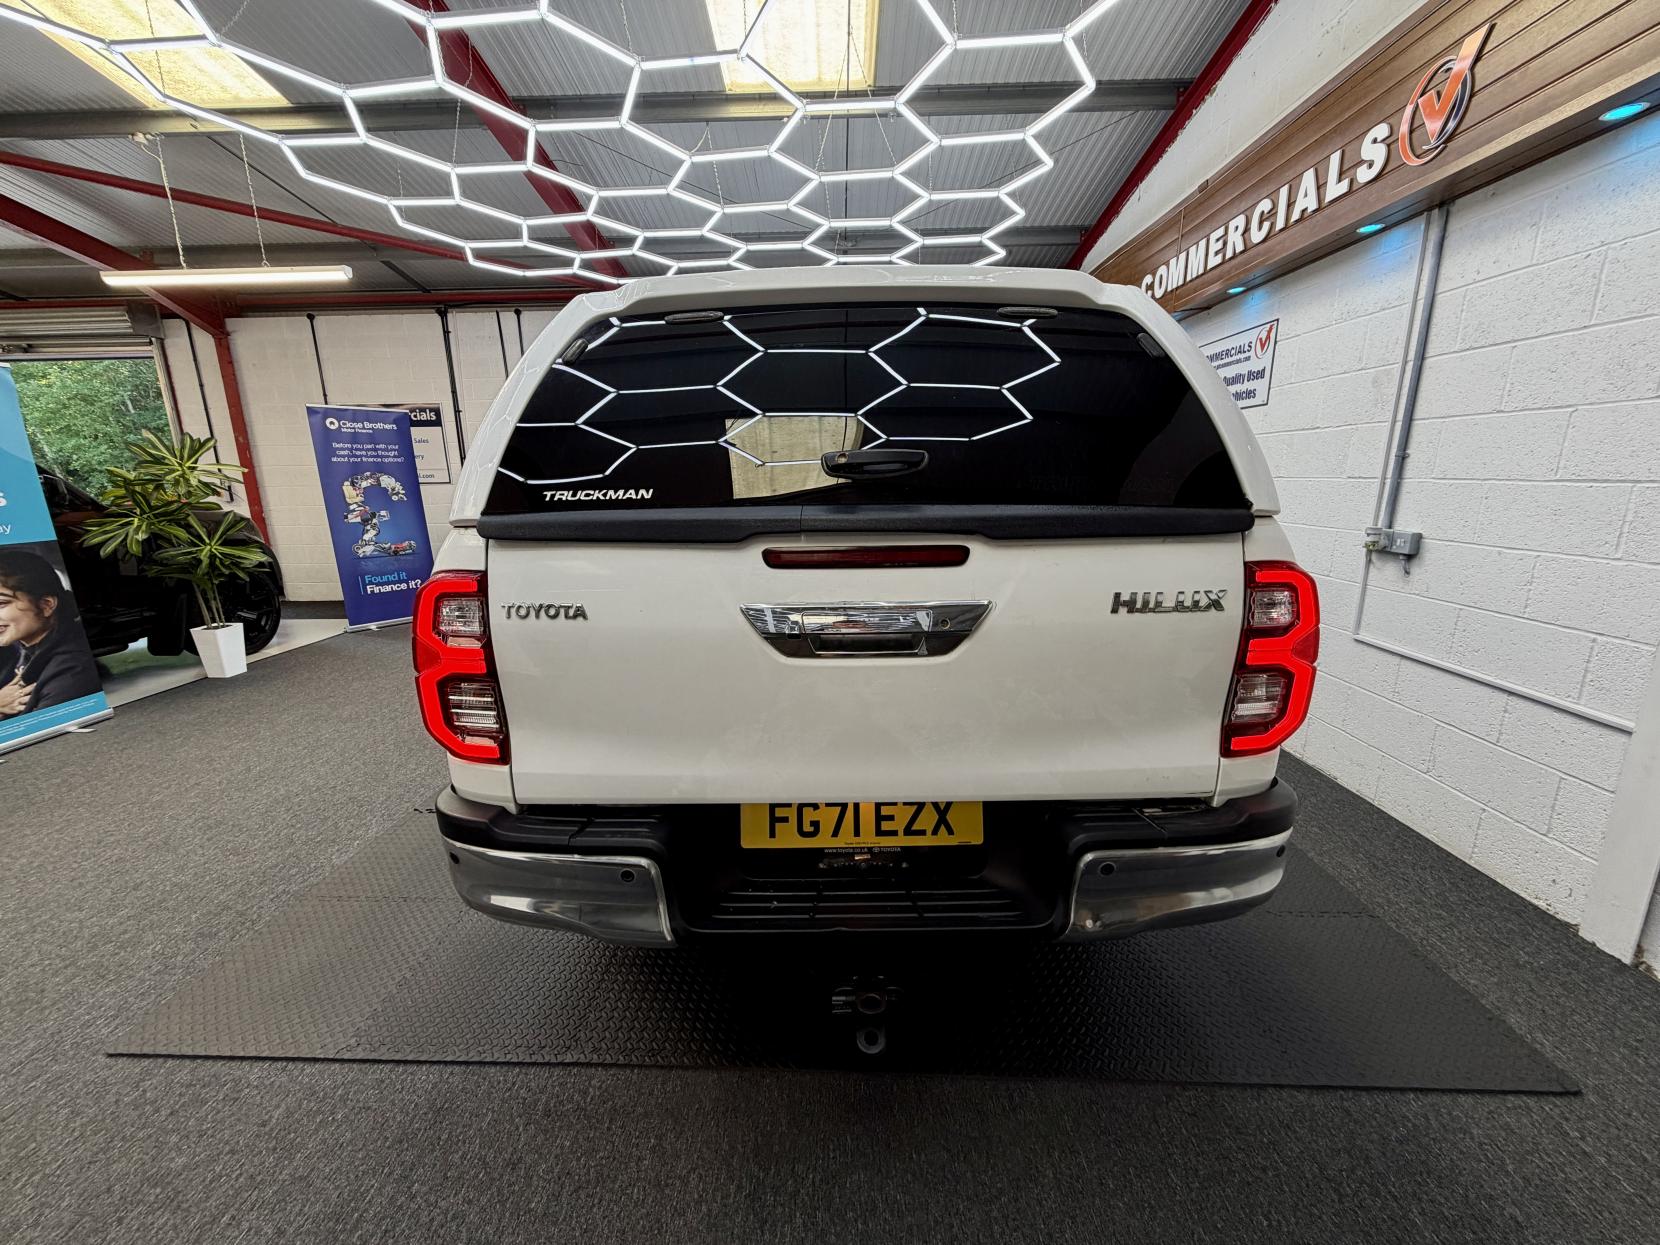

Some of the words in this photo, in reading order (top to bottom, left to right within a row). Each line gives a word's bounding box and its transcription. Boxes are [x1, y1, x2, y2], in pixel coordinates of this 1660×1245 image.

[1141, 122, 1391, 299] COMMERCIALS
[1206, 341, 1252, 363] MMERCIALS
[1247, 366, 1266, 383] Used
[409, 409, 436, 421] cials
[340, 420, 363, 429] Close
[363, 421, 398, 430] Brothers
[542, 488, 654, 501] TRUCKMAN
[364, 571, 399, 584] Found
[399, 571, 408, 580] it
[366, 582, 408, 595] Finance
[408, 579, 422, 589] it?
[1110, 589, 1228, 614] HILUX
[501, 602, 589, 621] TOYOTA
